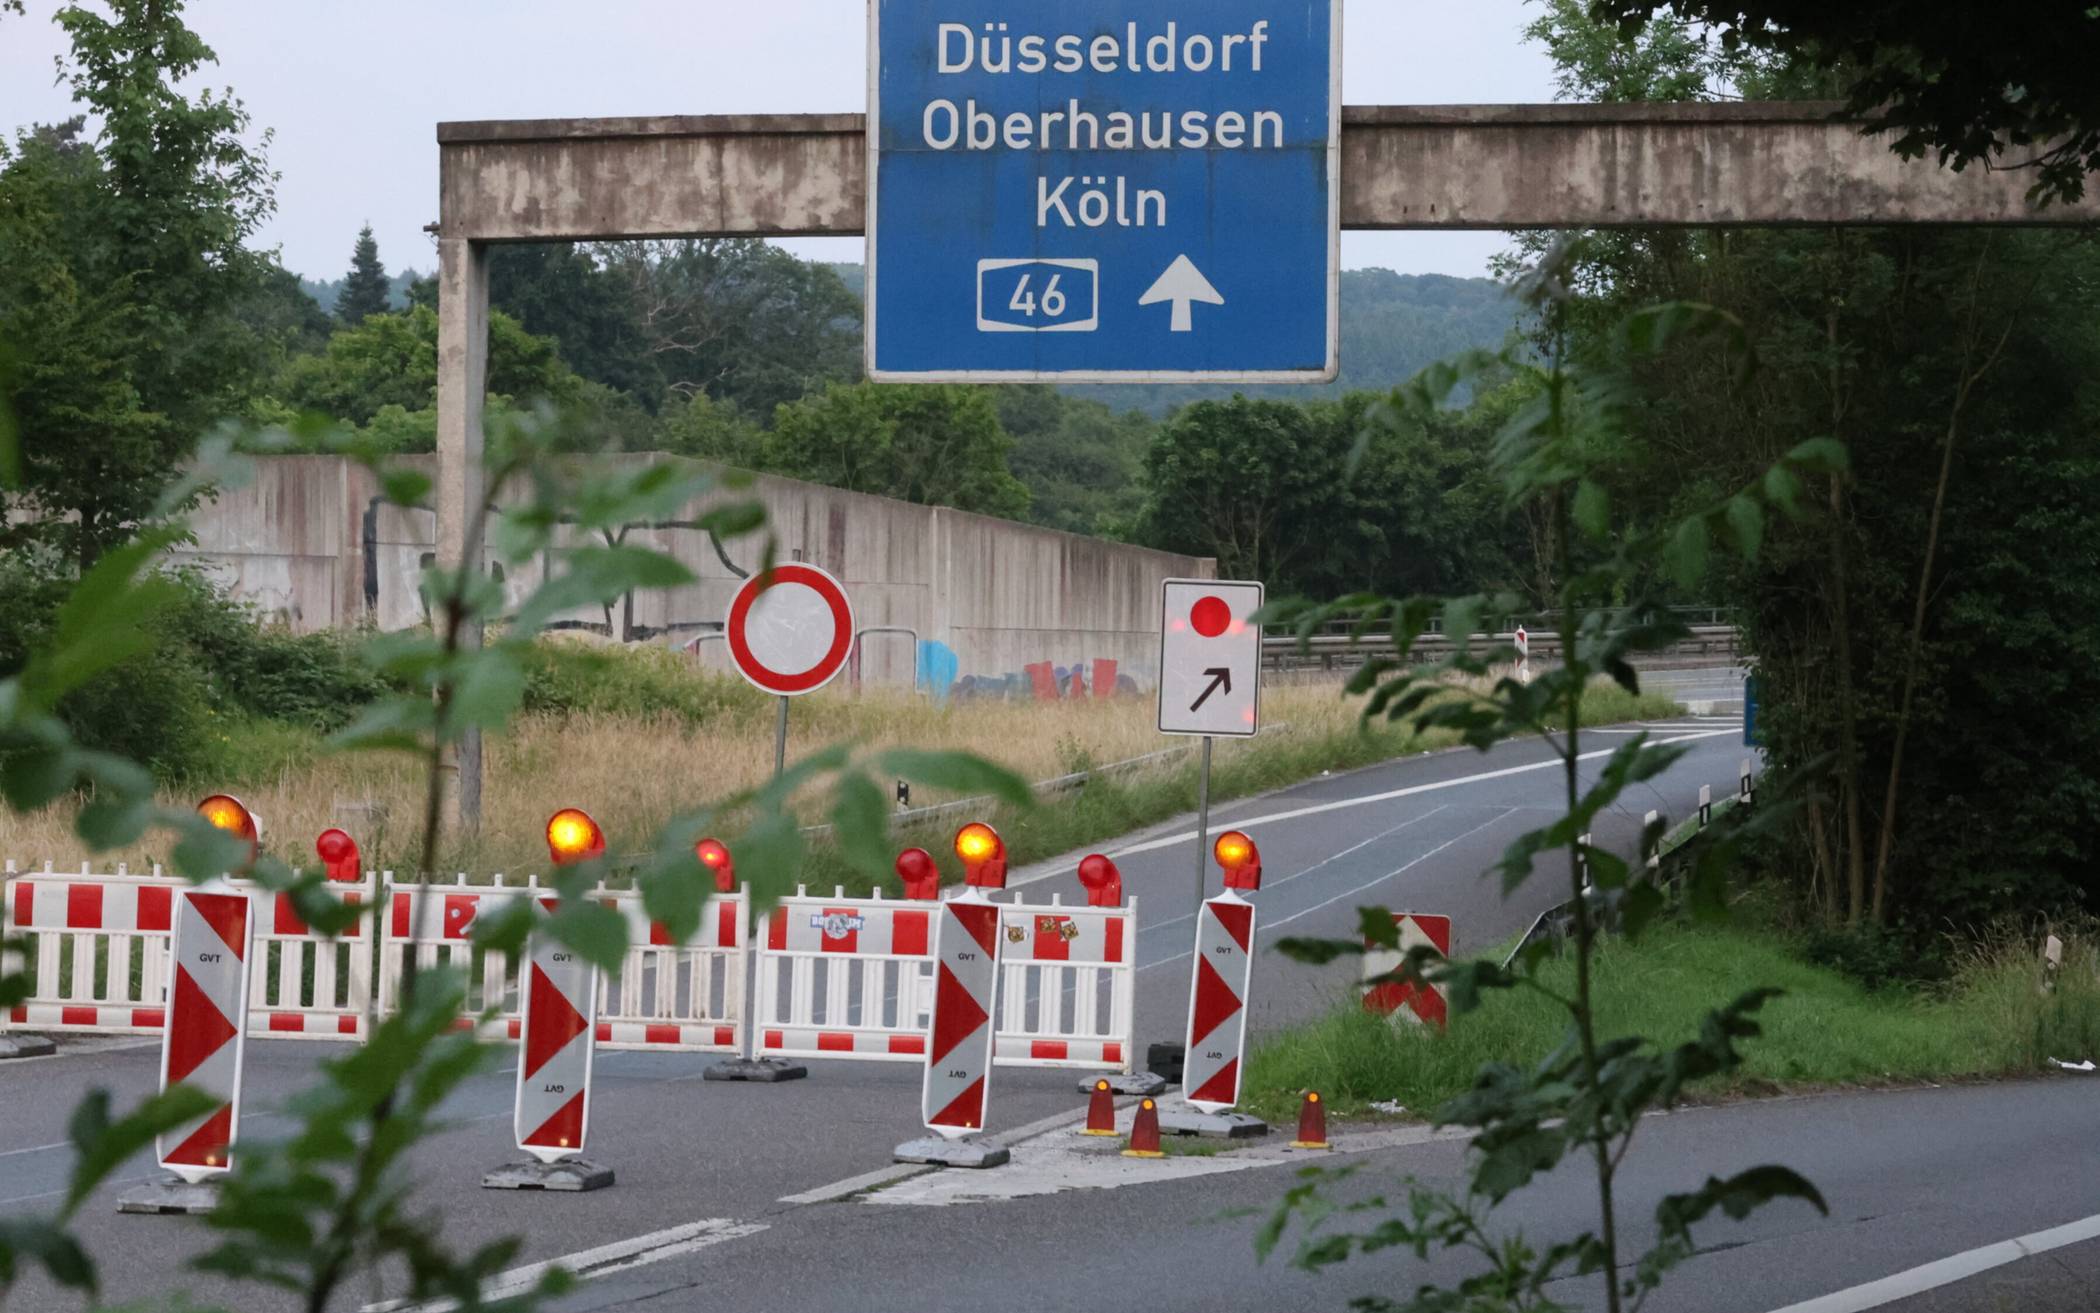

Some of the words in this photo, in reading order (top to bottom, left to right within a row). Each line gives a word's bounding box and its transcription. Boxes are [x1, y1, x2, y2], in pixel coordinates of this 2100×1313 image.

[937, 20, 1269, 74] Düsseldorf
[923, 99, 1283, 150] Oberhausen
[1037, 176, 1166, 227] Köln
[1008, 274, 1066, 316] 46
[200, 953, 221, 962] GVT
[553, 953, 573, 962] GVT
[958, 953, 976, 961] GVT
[1207, 1051, 1222, 1059] GVT
[949, 1070, 967, 1078] GVT
[545, 1084, 564, 1093] GVT
